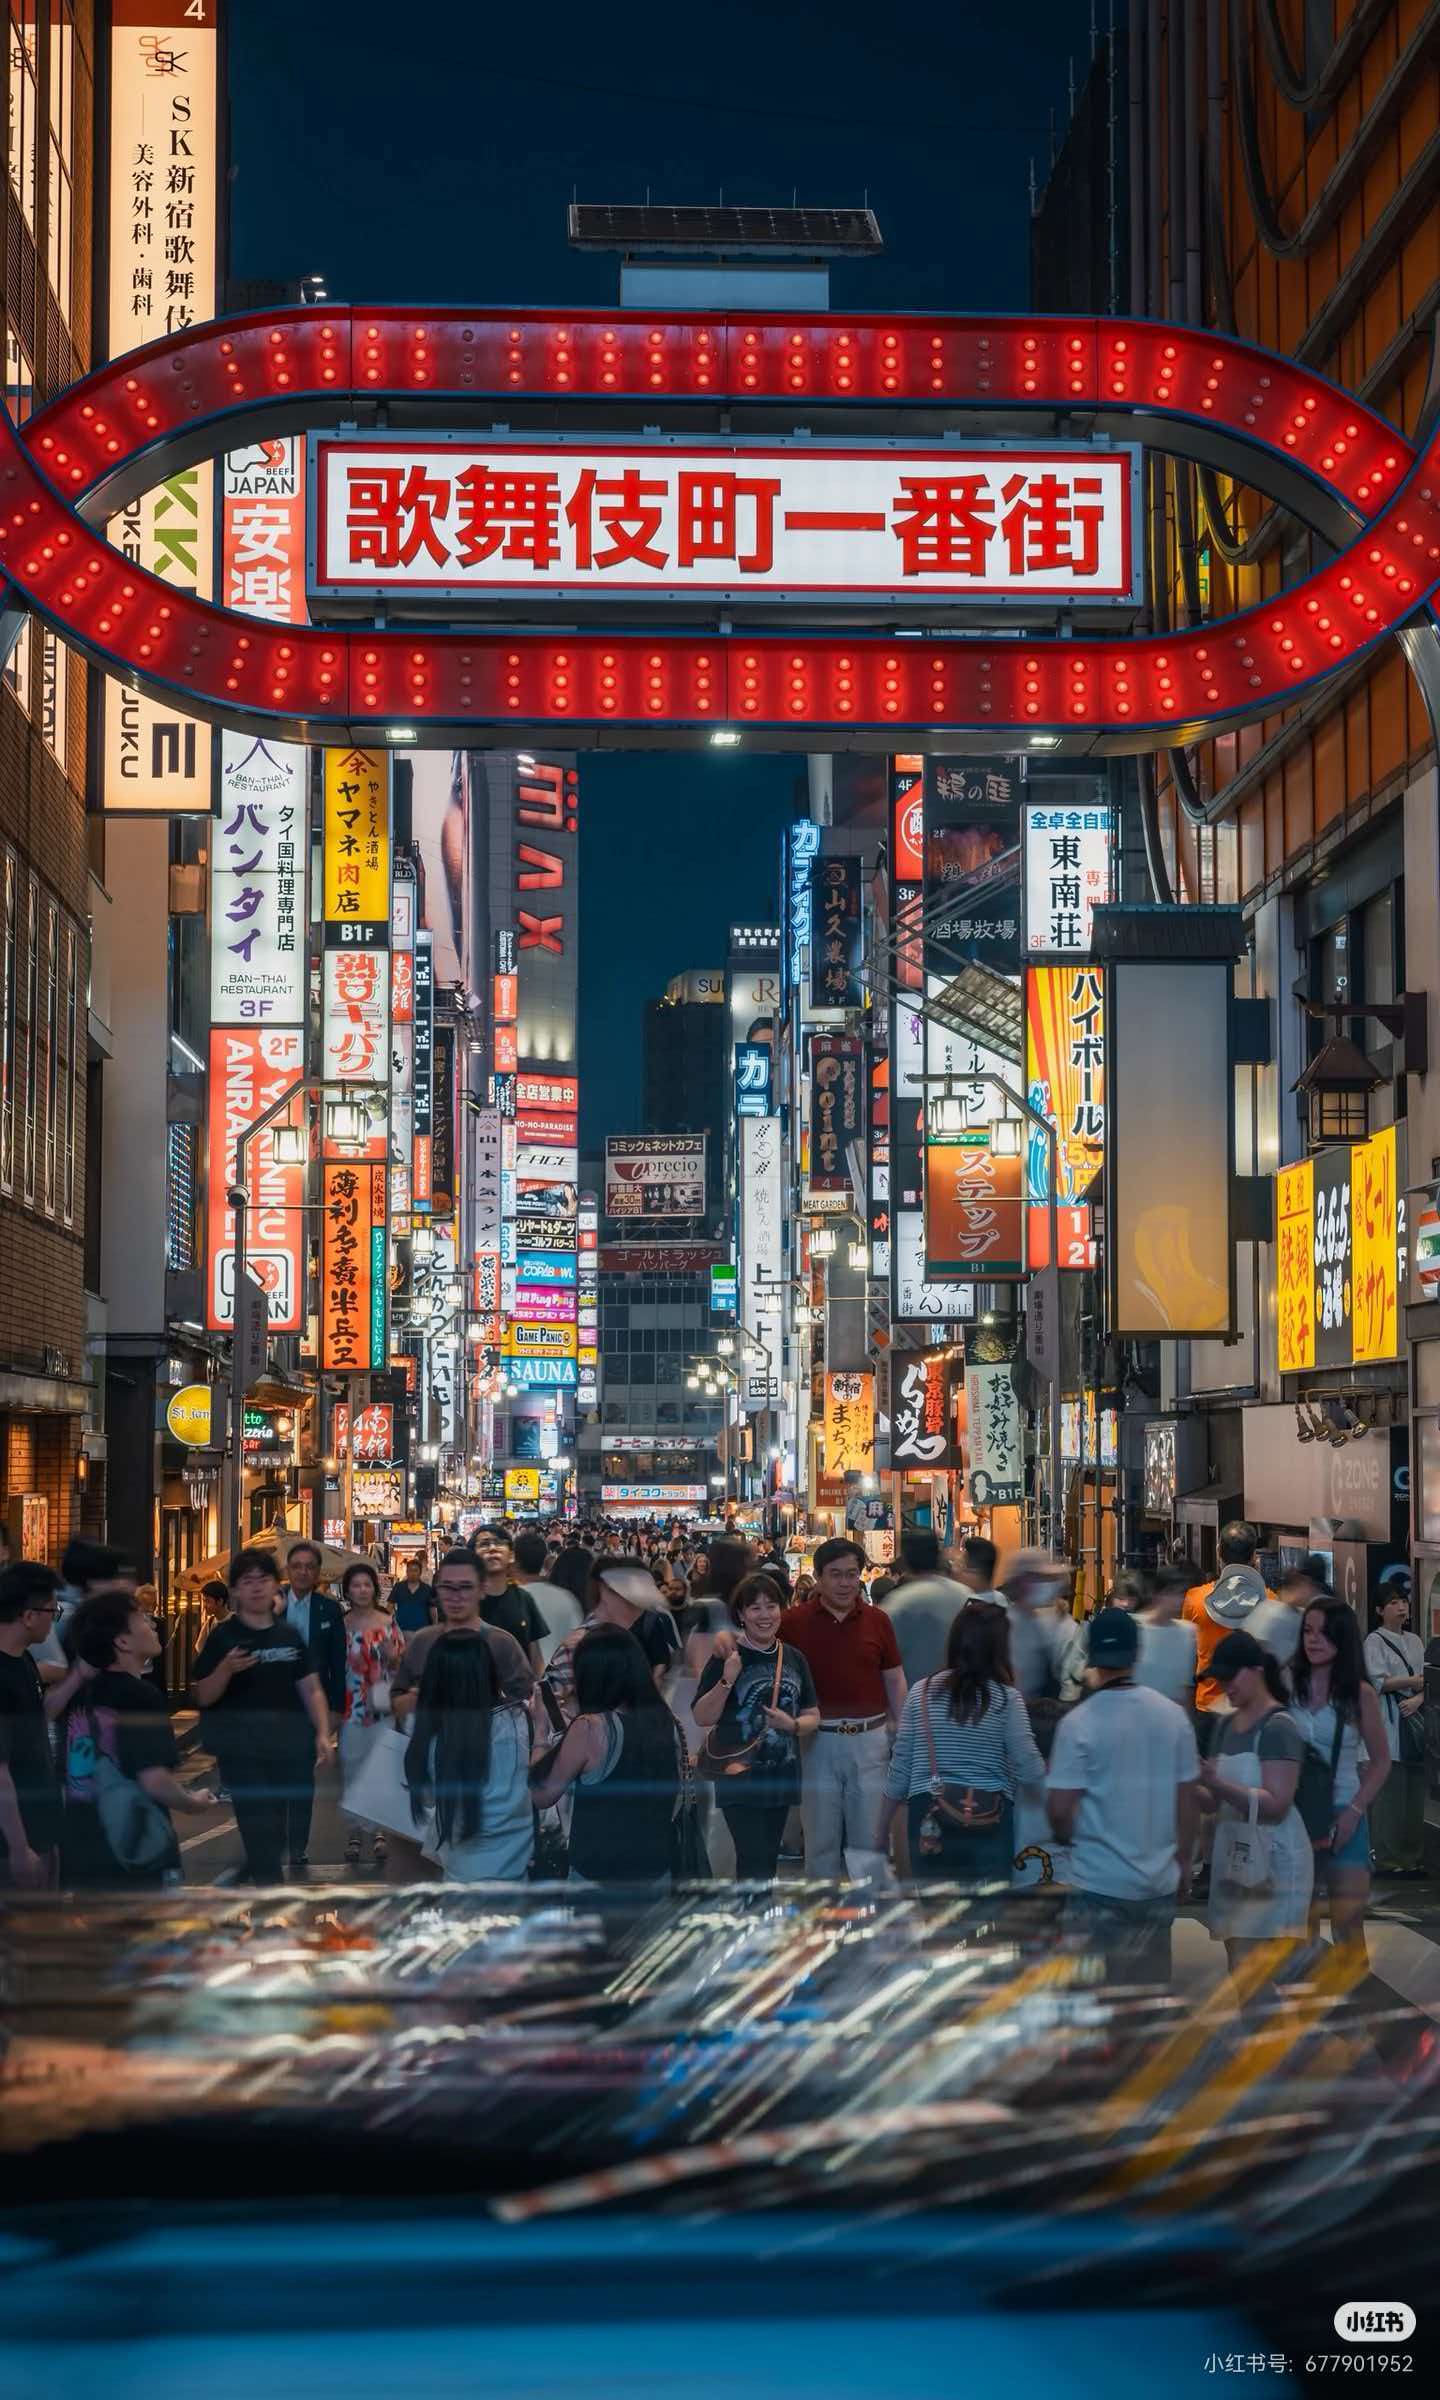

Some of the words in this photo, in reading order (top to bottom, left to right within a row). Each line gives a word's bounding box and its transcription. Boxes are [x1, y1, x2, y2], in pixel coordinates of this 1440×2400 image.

[132, 144, 154, 316] 美容外科・歯科
[265, 467, 291, 476] BEEF
[228, 477, 295, 494] JAPAN
[346, 465, 1104, 577] 歌舞伎町一番街
[227, 778, 292, 792] RESTAURANT
[235, 773, 284, 783] BAN-THAI
[898, 779, 912, 791] 4F
[334, 782, 361, 914] ヤマネ肉店
[223, 803, 270, 962] バンタイ
[277, 805, 295, 951] タイ国料理専門店
[898, 888, 916, 900] 3F
[1049, 835, 1082, 948] 東南荘
[341, 925, 374, 941] B1F
[1031, 935, 1047, 947] 3F
[229, 975, 287, 983] BAN-THAI
[220, 985, 294, 995] RESTAURANT
[240, 999, 274, 1017] 3F
[270, 1038, 299, 1056] 2F
[1068, 973, 1104, 1137] ハイボール
[802, 1200, 820, 1210] MEAT
[821, 1200, 847, 1210] GARDEN
[954, 1151, 1001, 1259] ステップ
[617, 1249, 725, 1262] ゴールドラッシュ
[638, 1261, 689, 1270] ハンバーグ
[971, 1263, 985, 1272] B1
[267, 1291, 284, 1299] EEF
[946, 1303, 973, 1315] B1F
[516, 1326, 539, 1342] GAME
[540, 1326, 562, 1343] PANIC
[511, 1360, 577, 1382] SAUNA
[985, 1373, 1017, 1473] お好み焼き
[832, 1403, 853, 1471] まっちゃん
[998, 1487, 1022, 1500] B1F
